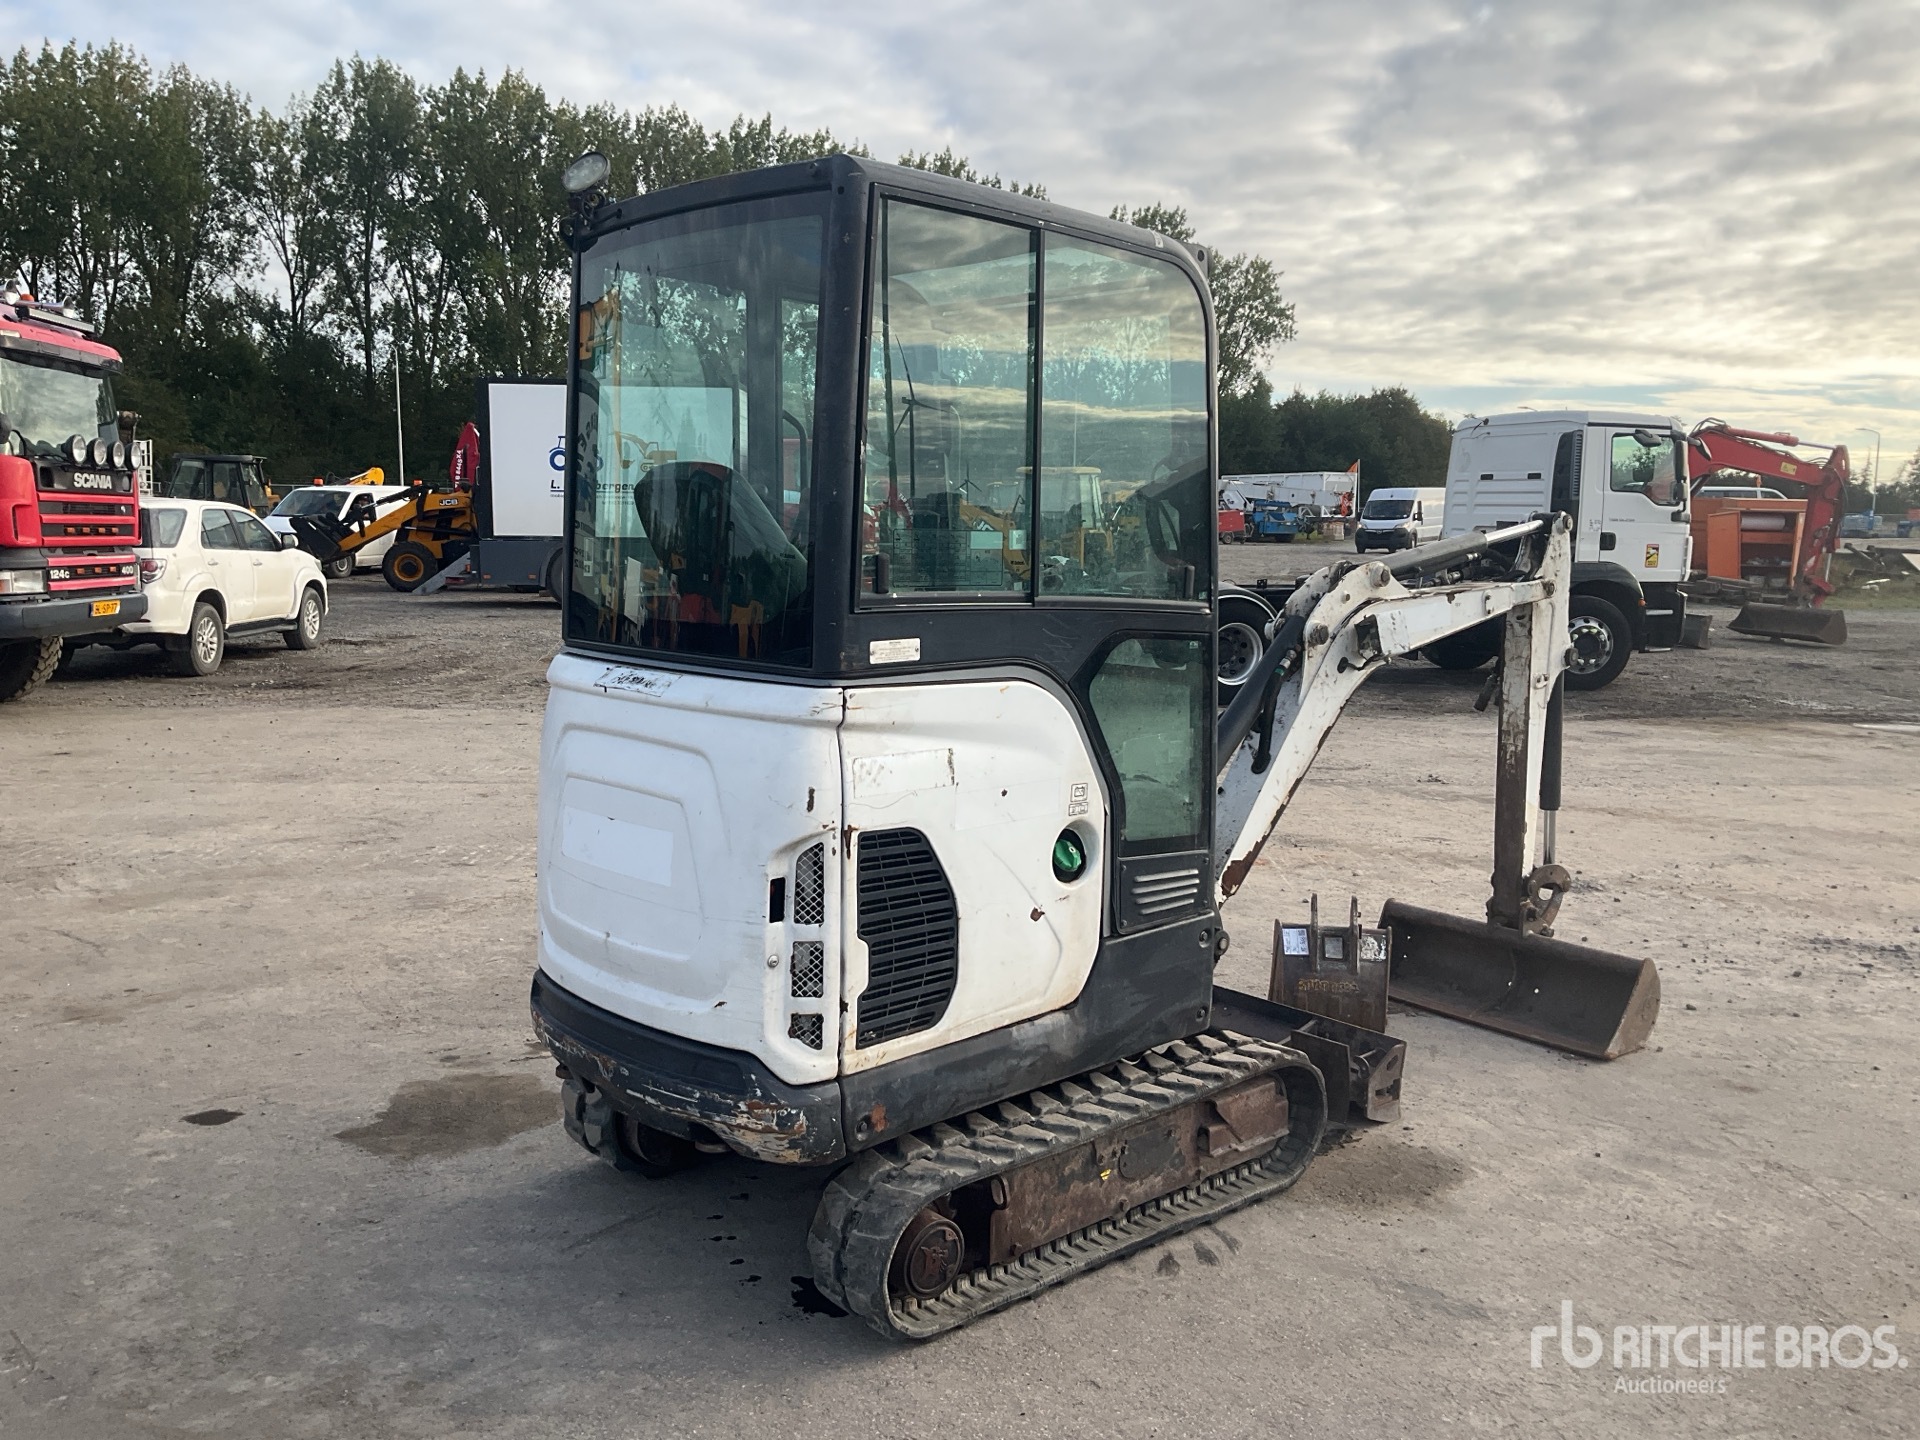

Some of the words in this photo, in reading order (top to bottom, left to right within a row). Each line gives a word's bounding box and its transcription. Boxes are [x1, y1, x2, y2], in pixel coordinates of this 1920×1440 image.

[73, 472, 112, 489] SCANIA
[550, 480, 560, 489] L.
[439, 498, 458, 506] JCB
[121, 565, 134, 575] 400
